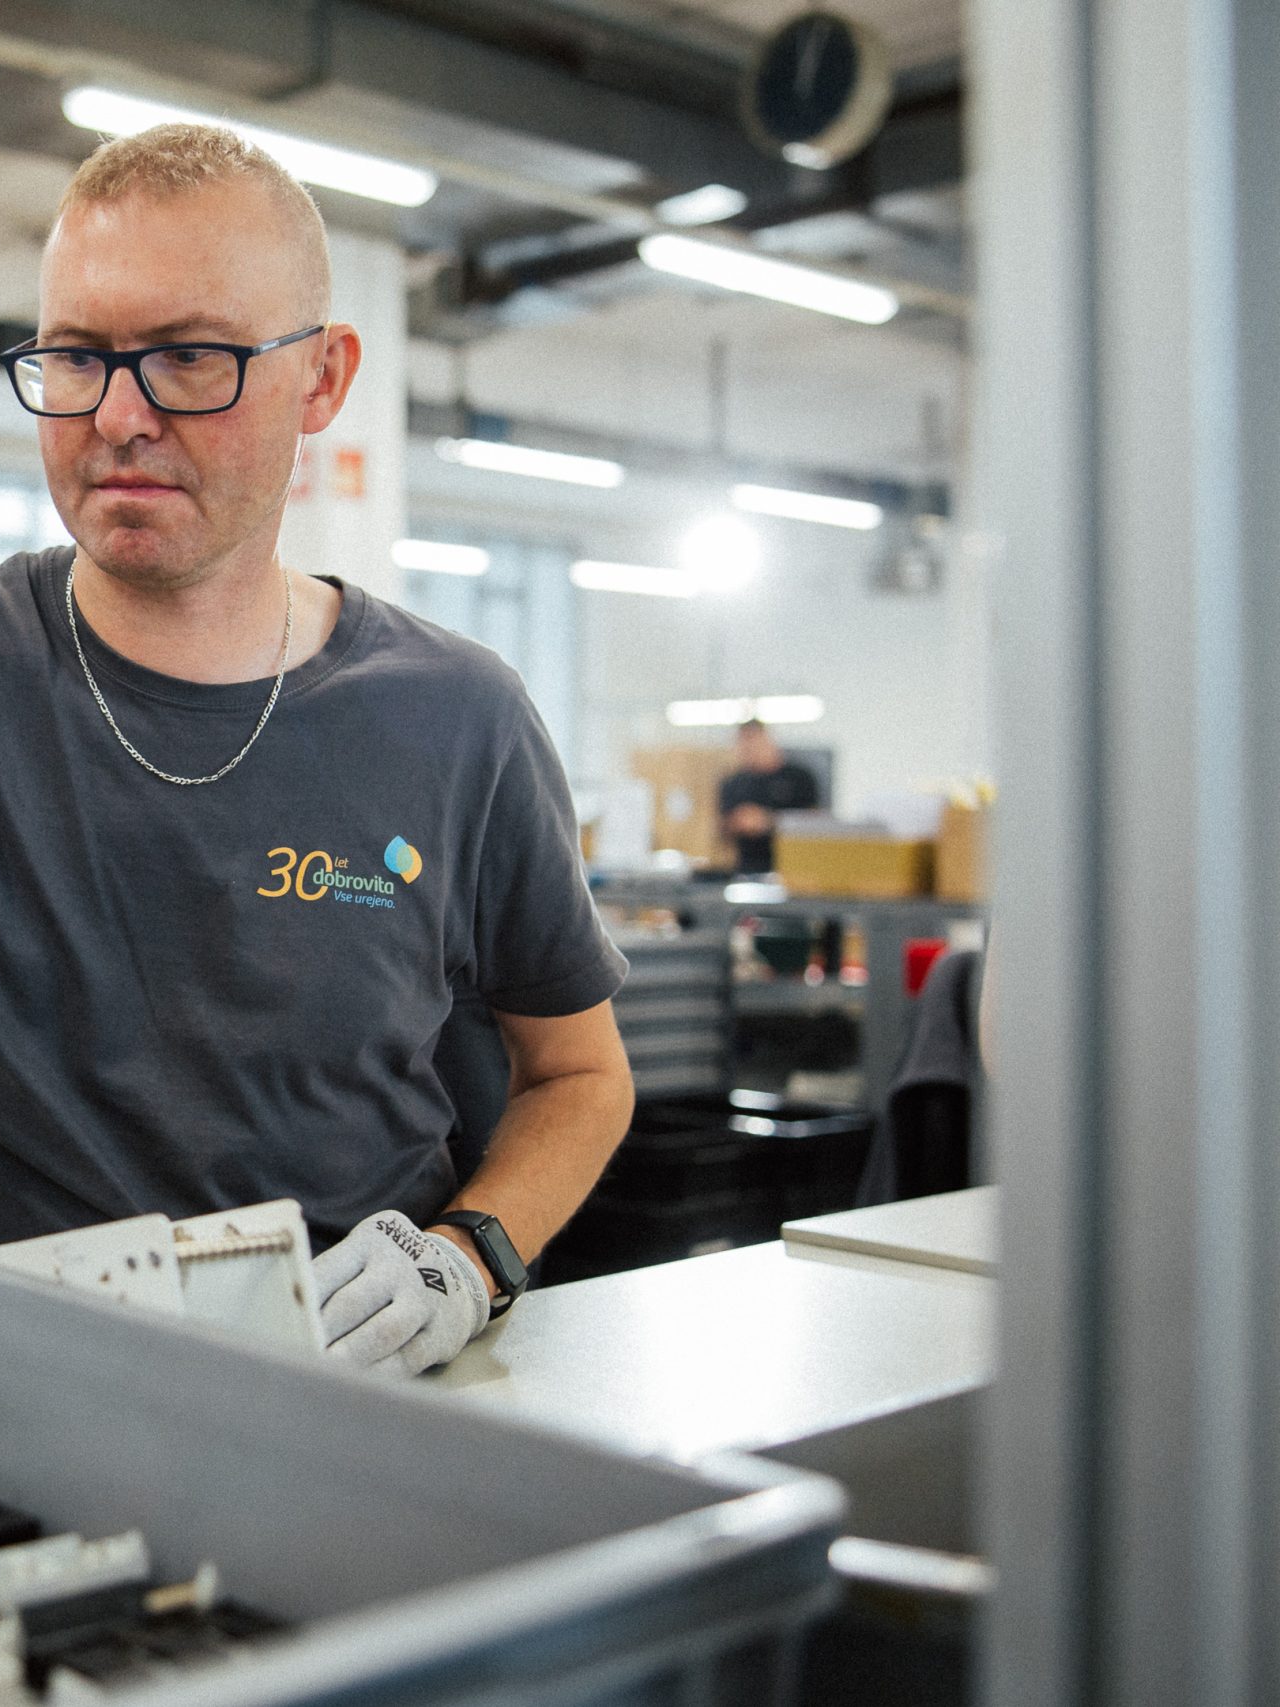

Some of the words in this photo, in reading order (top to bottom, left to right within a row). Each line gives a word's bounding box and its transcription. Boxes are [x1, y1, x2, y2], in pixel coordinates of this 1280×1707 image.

[256, 847, 333, 901] 30
[334, 856, 349, 869] let
[313, 868, 394, 895] dobrovita
[334, 890, 353, 903] Vse
[355, 894, 396, 909] urejeno.
[376, 1220, 421, 1262] NITRAS
[389, 1218, 427, 1253] SAFETY
